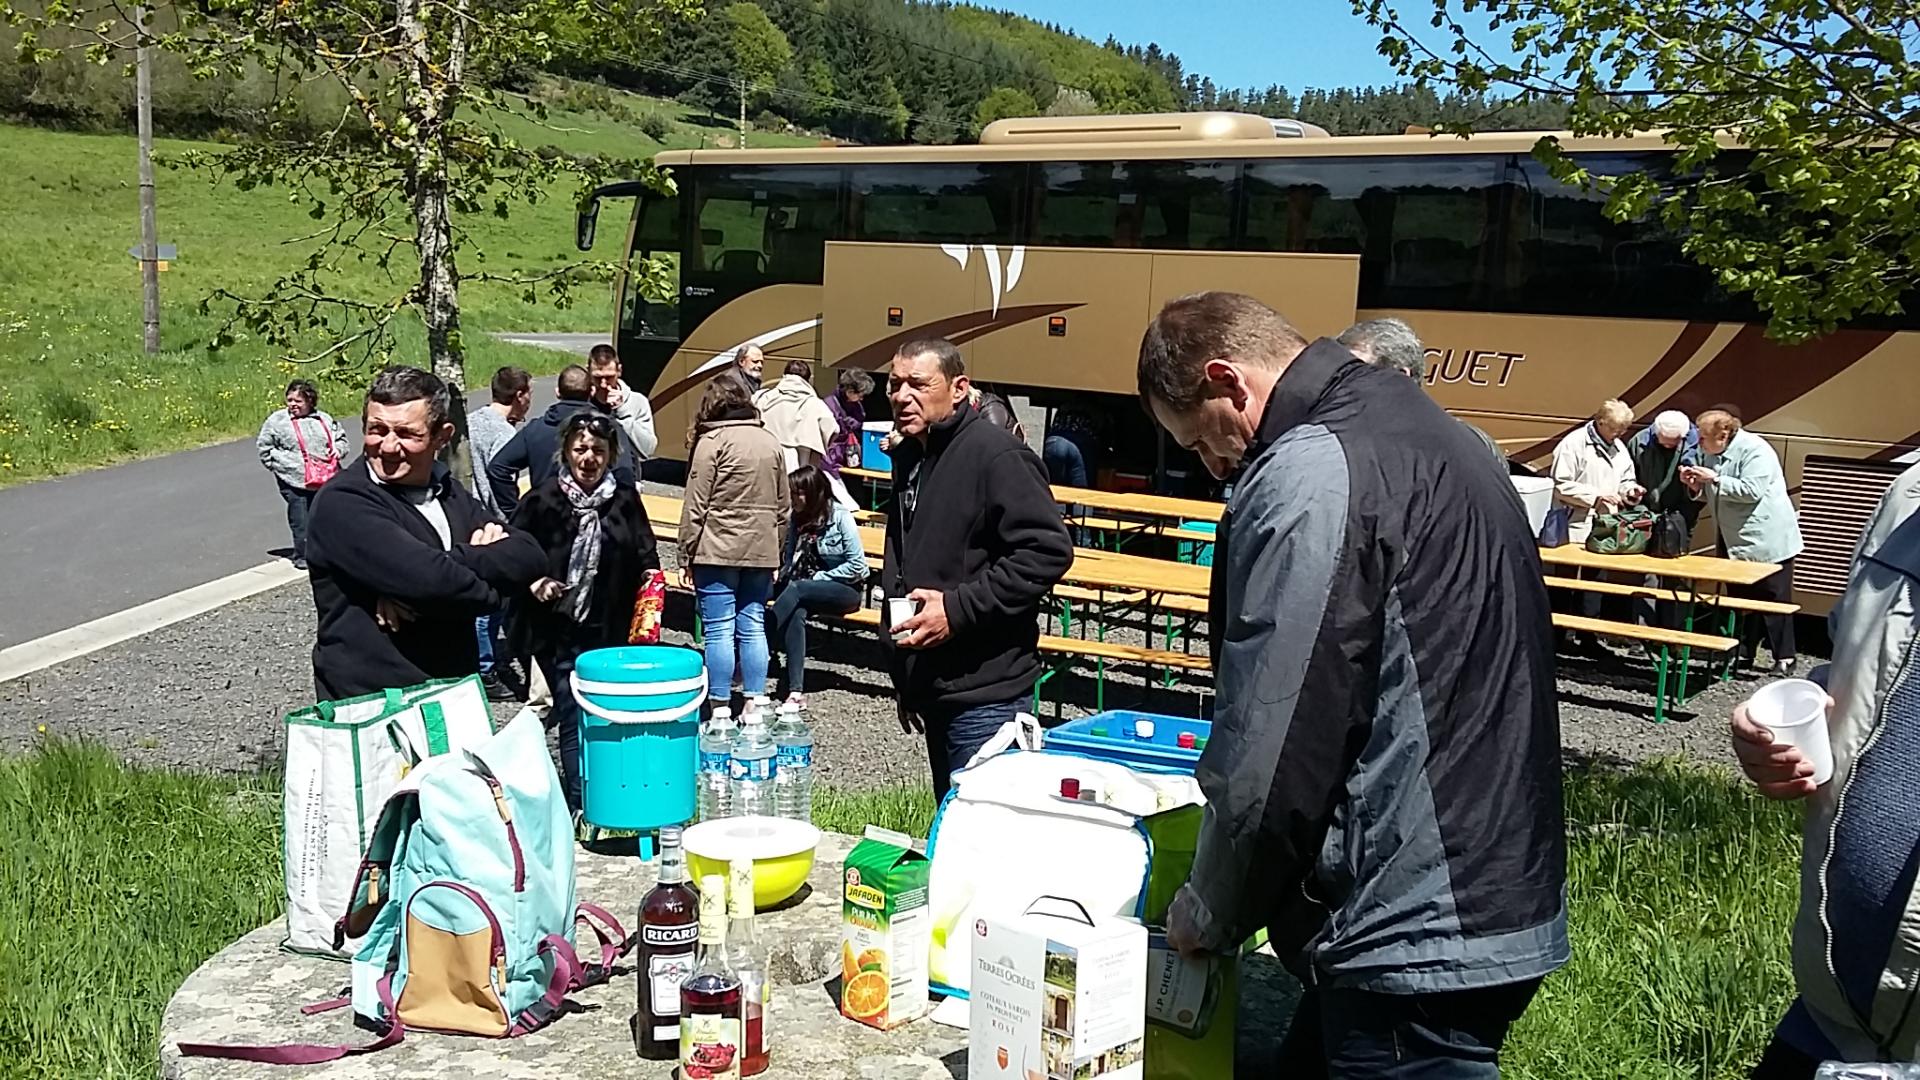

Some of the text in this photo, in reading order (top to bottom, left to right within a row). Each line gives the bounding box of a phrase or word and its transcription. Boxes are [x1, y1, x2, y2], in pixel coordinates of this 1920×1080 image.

[848, 888, 883, 905] JAFADEN
[647, 927, 698, 941] RICARD
[1160, 952, 1175, 996] CHENET
